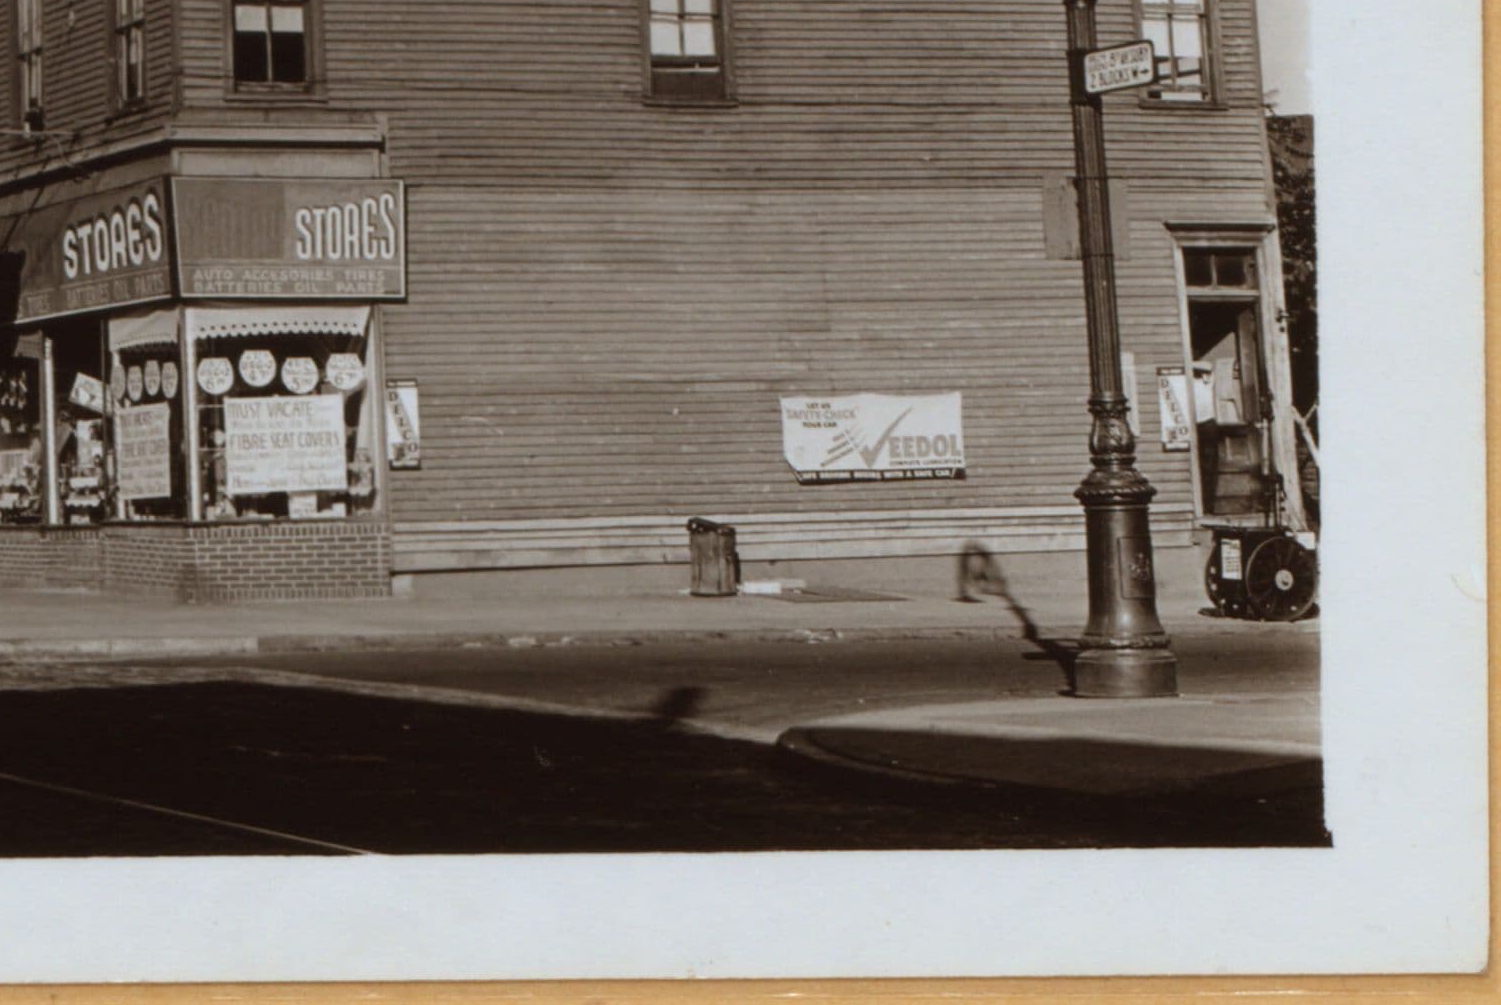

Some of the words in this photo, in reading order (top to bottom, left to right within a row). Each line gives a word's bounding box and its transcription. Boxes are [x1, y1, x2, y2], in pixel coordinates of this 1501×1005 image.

[63, 193, 162, 279] STORES
[296, 193, 396, 260] STORES
[194, 269, 233, 282] AUTO
[344, 269, 386, 282] TIRES
[194, 281, 283, 293] BATTERIES
[336, 282, 386, 294] PARTS
